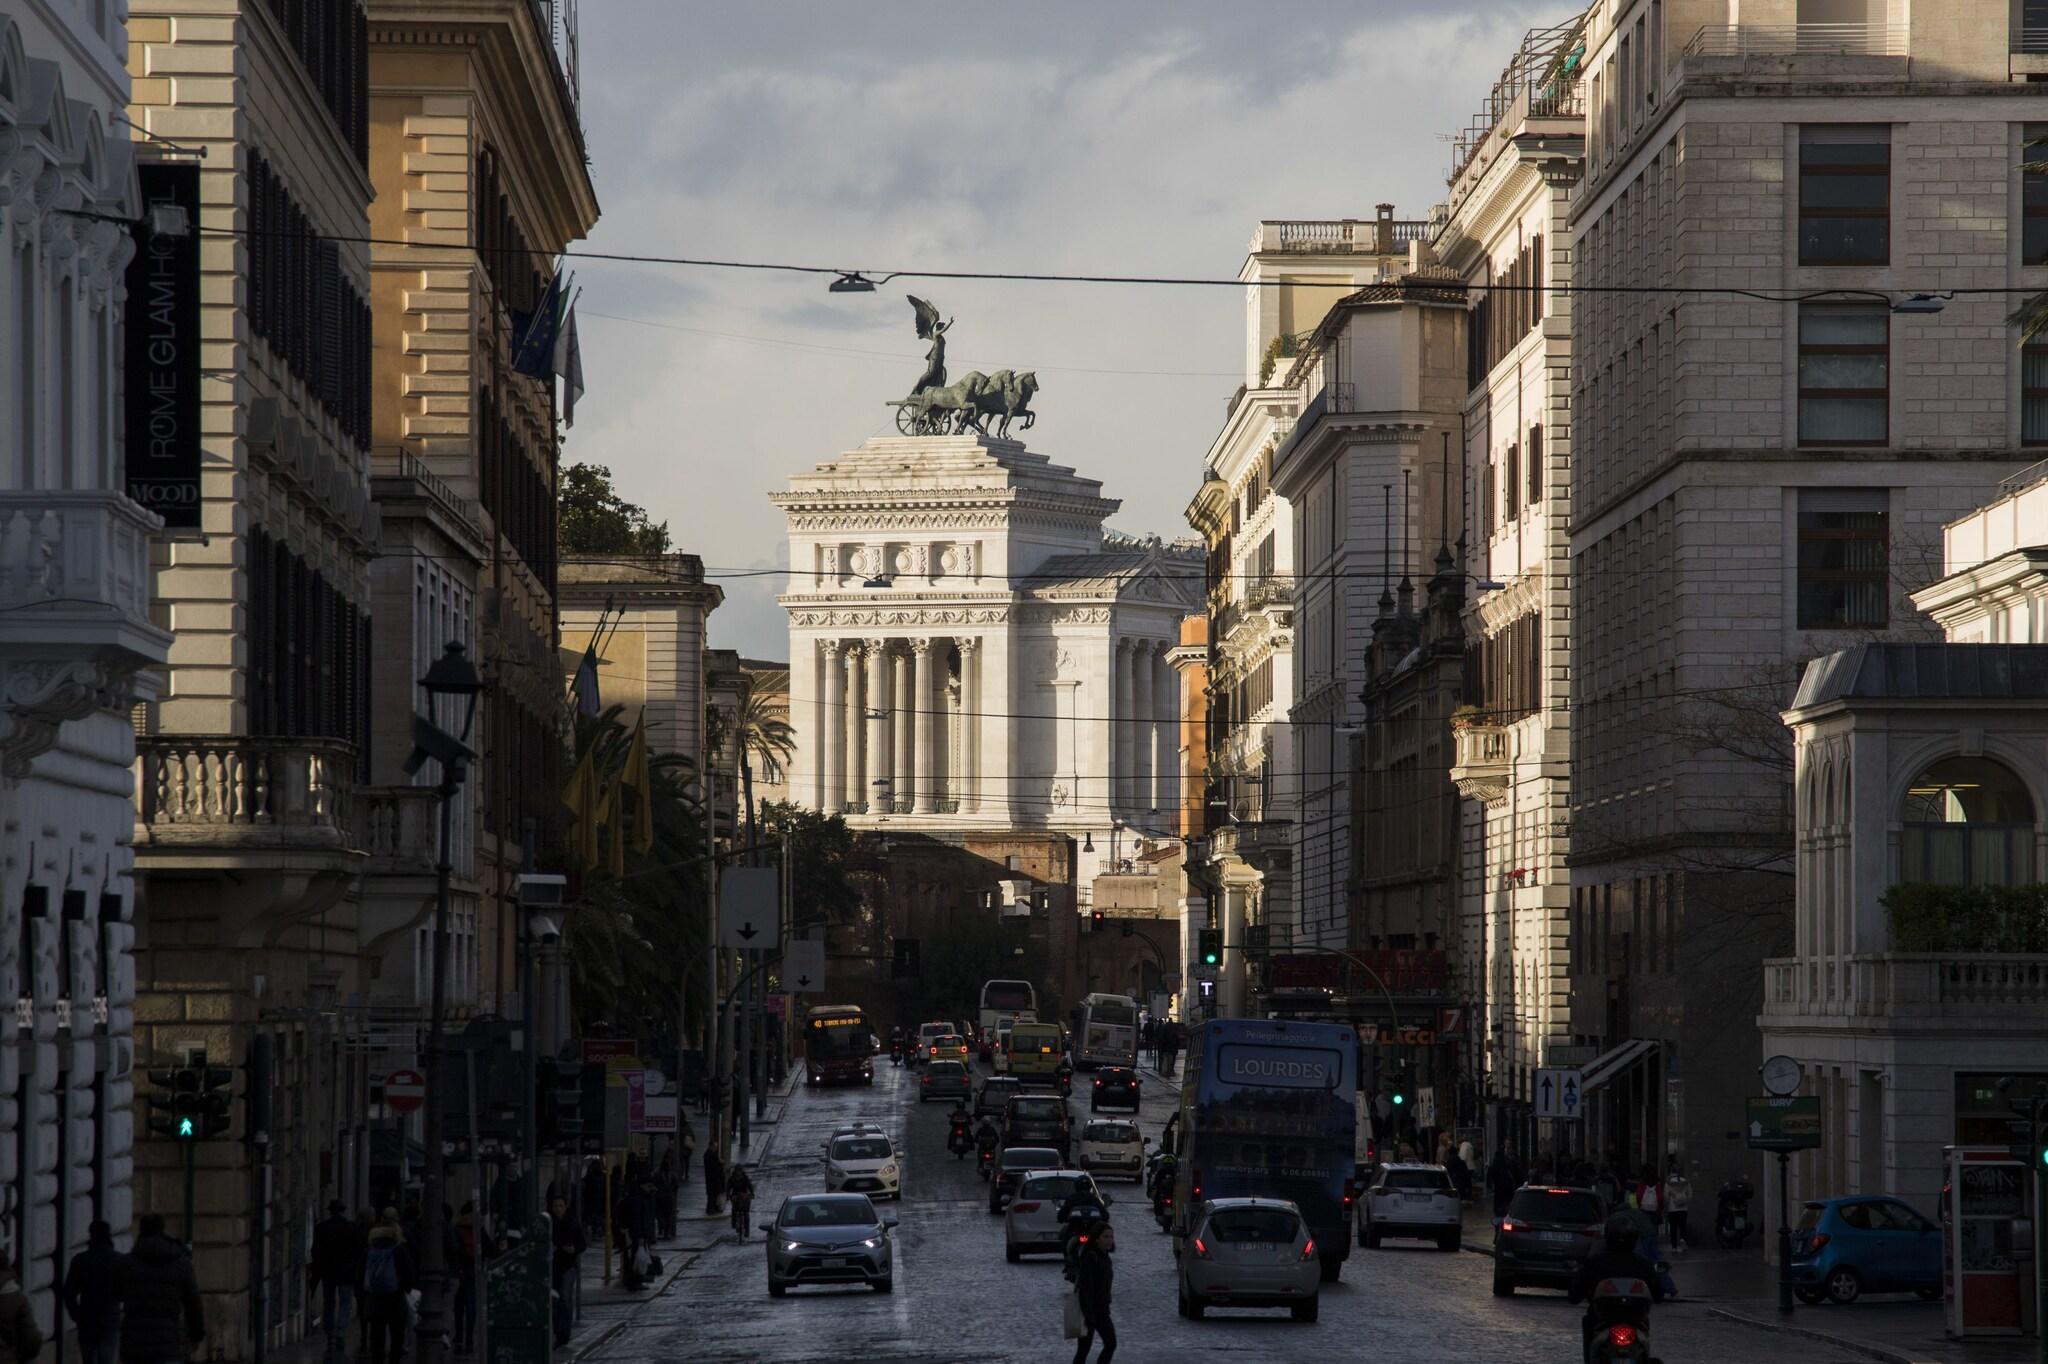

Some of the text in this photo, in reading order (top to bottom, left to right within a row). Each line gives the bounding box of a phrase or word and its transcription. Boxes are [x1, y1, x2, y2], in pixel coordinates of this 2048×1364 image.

[148, 371, 177, 459] ROME
[130, 484, 198, 504] MOOD
[1200, 982, 1213, 996] T
[1445, 1009, 1461, 1033] 7
[1233, 1058, 1324, 1079] LOURDES
